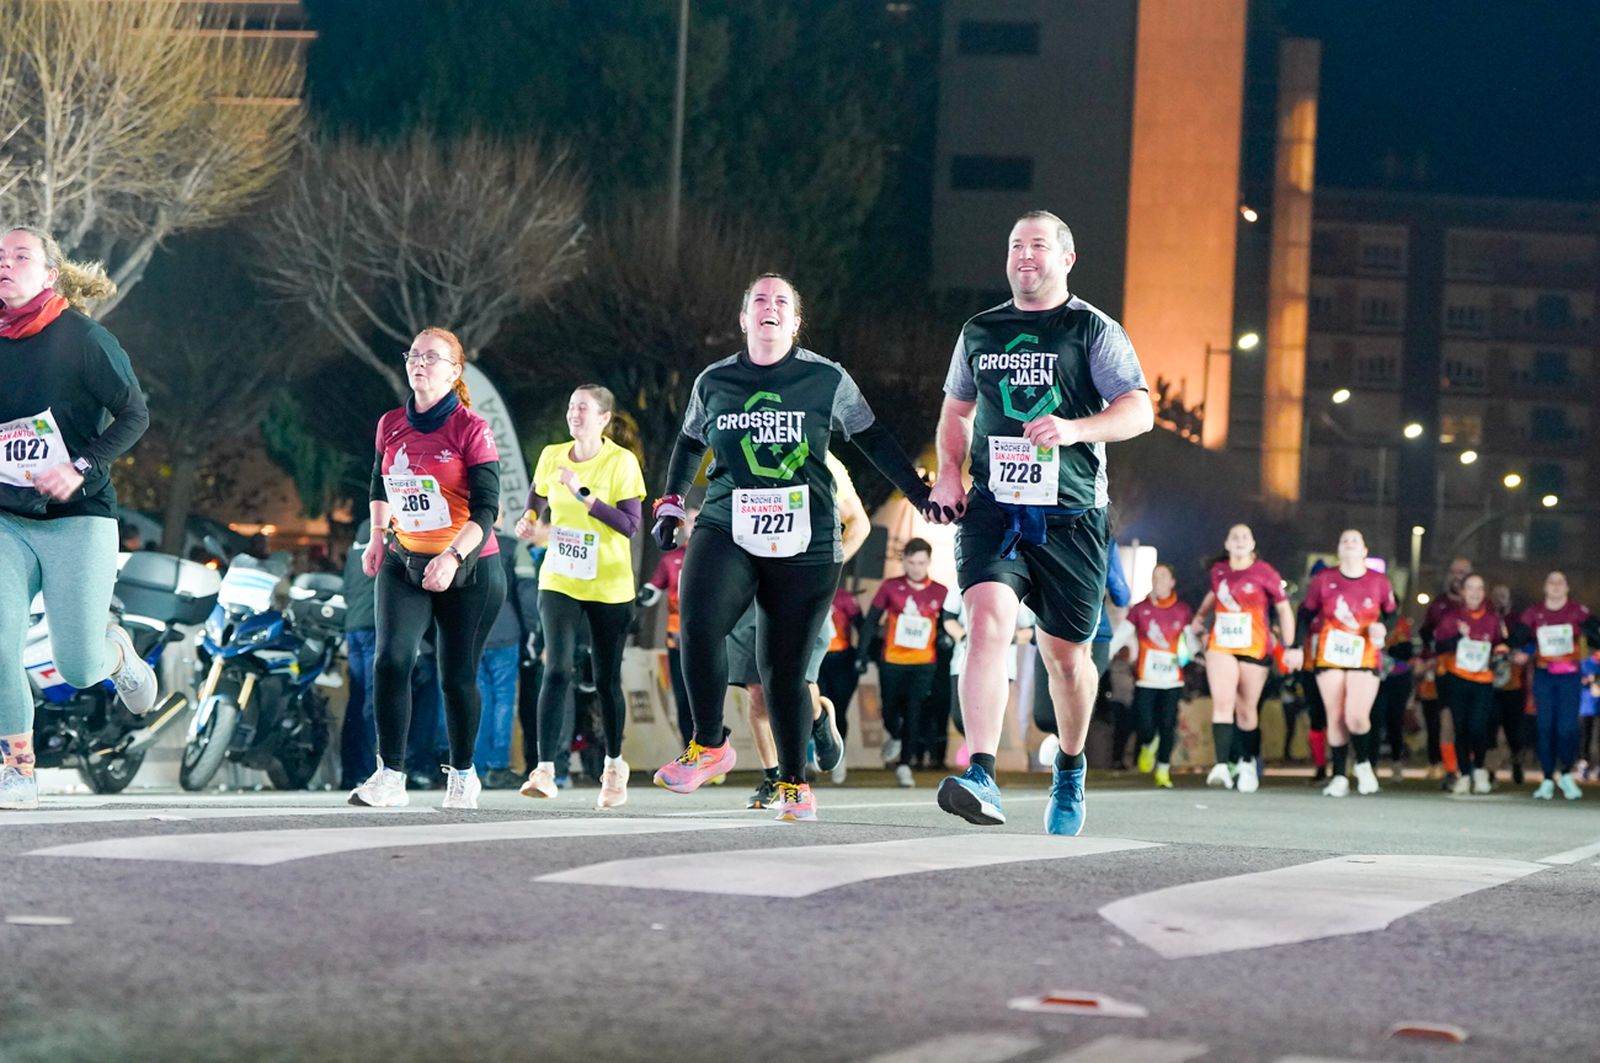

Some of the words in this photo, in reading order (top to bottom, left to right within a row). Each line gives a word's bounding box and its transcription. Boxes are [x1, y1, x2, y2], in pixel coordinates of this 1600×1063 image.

[979, 353, 1058, 370] CROSSFIT
[1010, 369, 1053, 386] JAEN
[717, 411, 806, 430] CROSSFIT
[752, 427, 802, 443] JAEN
[4, 438, 49, 461] 1027
[478, 397, 526, 524] PEMASA
[1000, 462, 1042, 483] 7228
[402, 493, 431, 511] 286
[741, 505, 757, 513] SAN
[750, 496, 772, 504] NOCHE
[774, 496, 782, 504] DE
[751, 513, 794, 535] 7227
[559, 542, 588, 560] 6263
